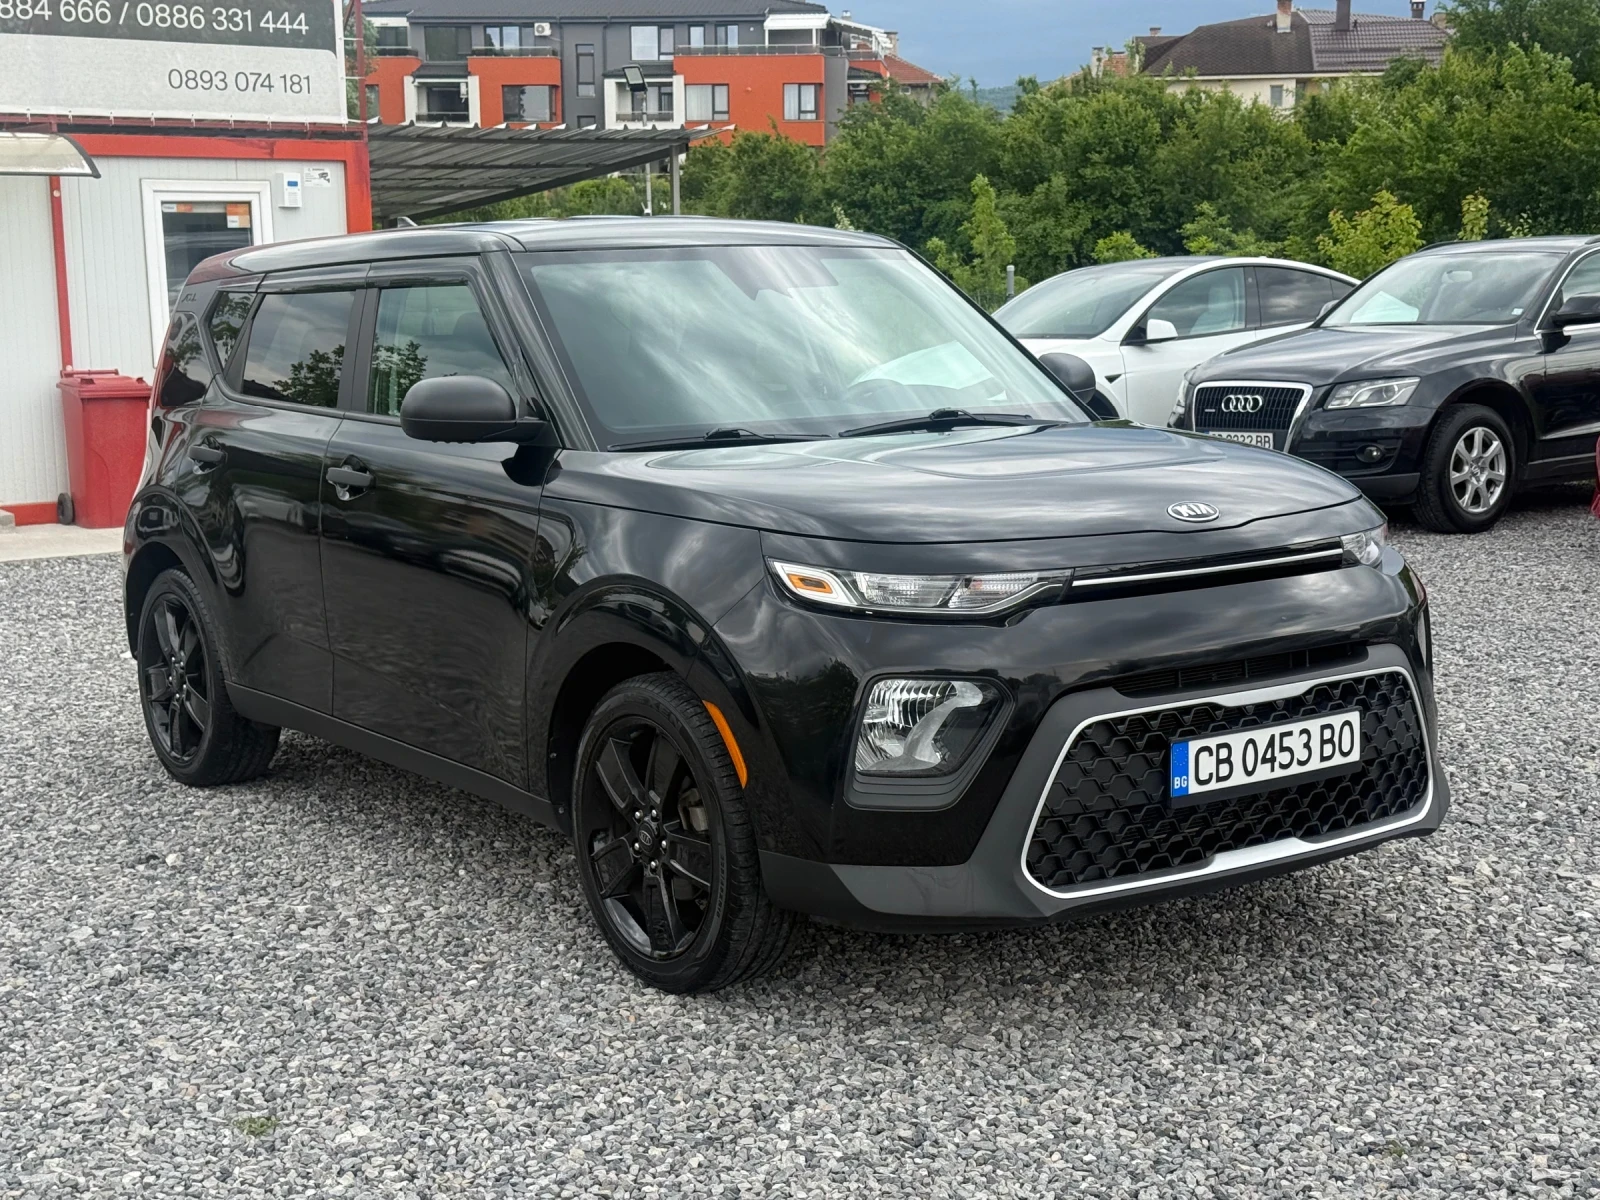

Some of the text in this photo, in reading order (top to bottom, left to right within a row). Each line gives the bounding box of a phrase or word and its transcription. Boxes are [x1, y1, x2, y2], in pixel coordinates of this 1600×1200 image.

[0, 0, 310, 35] 884 666 / 0886 331 444
[168, 69, 311, 95] 0893 074 181
[1171, 502, 1215, 517] KIA
[1194, 719, 1355, 786] CB 0453 BO
[1174, 776, 1188, 789] BG
